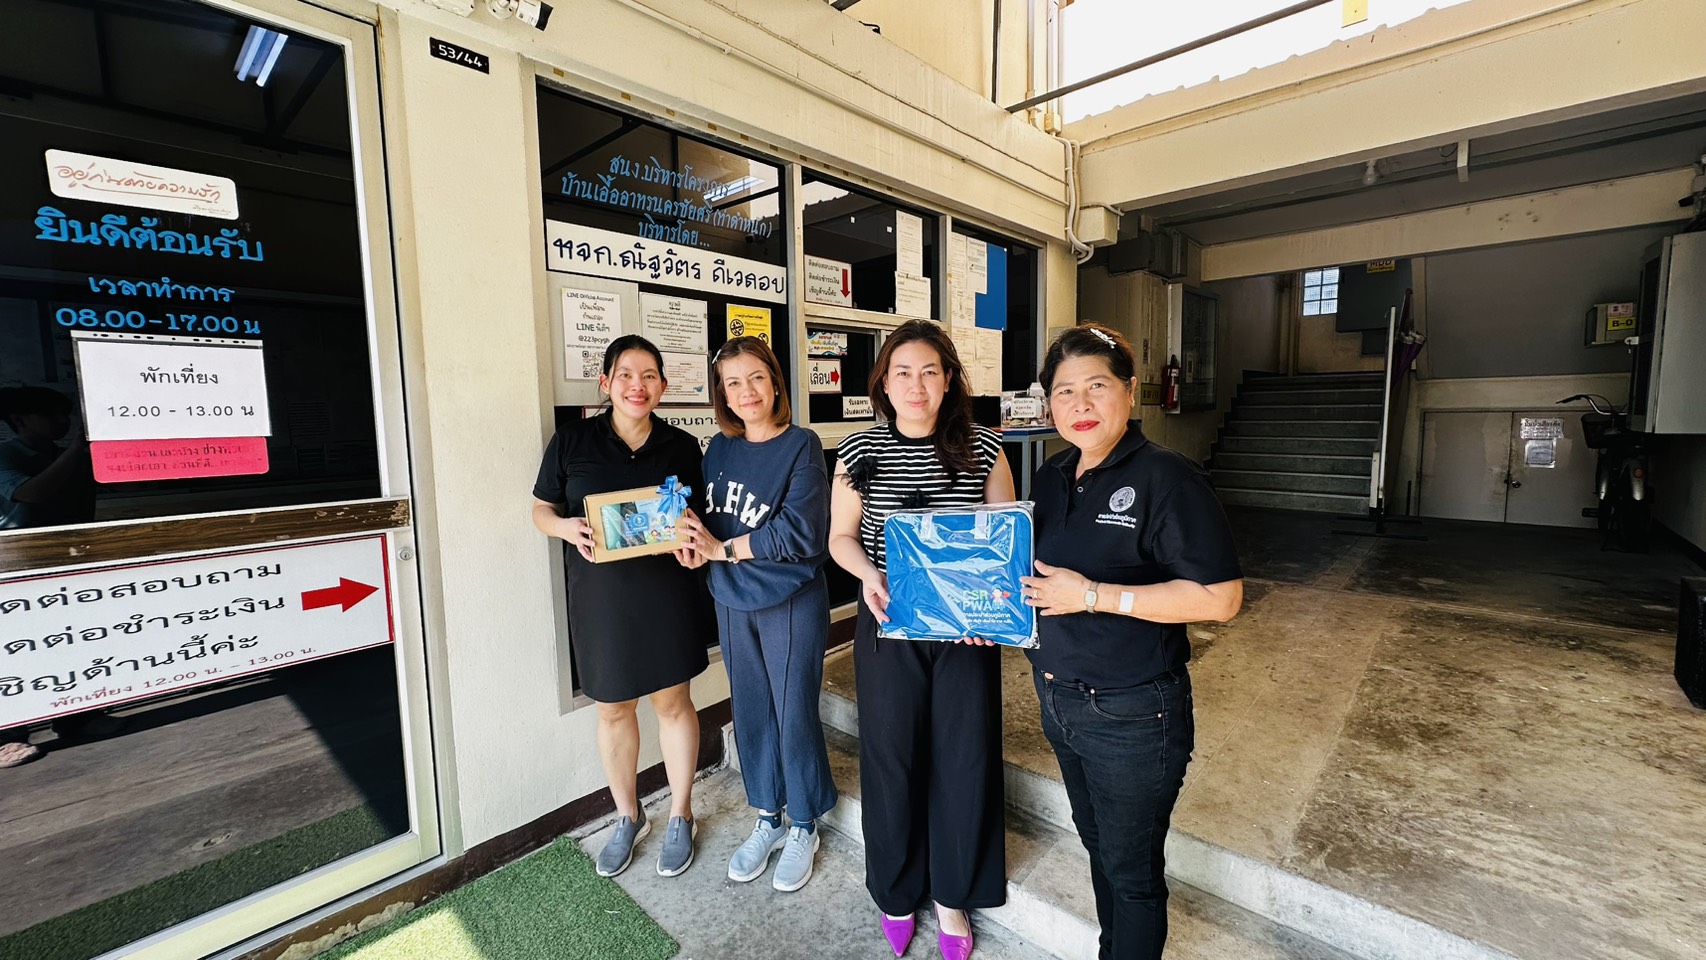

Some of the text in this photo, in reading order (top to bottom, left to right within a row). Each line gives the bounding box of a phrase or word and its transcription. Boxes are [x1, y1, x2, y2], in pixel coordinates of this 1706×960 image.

[439, 44, 482, 67] 53/44
[35, 206, 264, 261] ยินดีต้อนรับ
[89, 276, 235, 302] เวลาทำการ
[244, 318, 261, 334] น
[576, 323, 595, 331] LINE
[140, 363, 219, 385] พักเที่ยง
[810, 362, 830, 385] เลื่อน
[107, 405, 161, 417] 12.00
[186, 405, 234, 417] 13.00
[241, 405, 255, 417] น
[963, 601, 992, 611] PWA
[50, 685, 133, 709] พักเที่ยง
[144, 669, 197, 689] 12.00
[248, 650, 294, 667] 13.00
